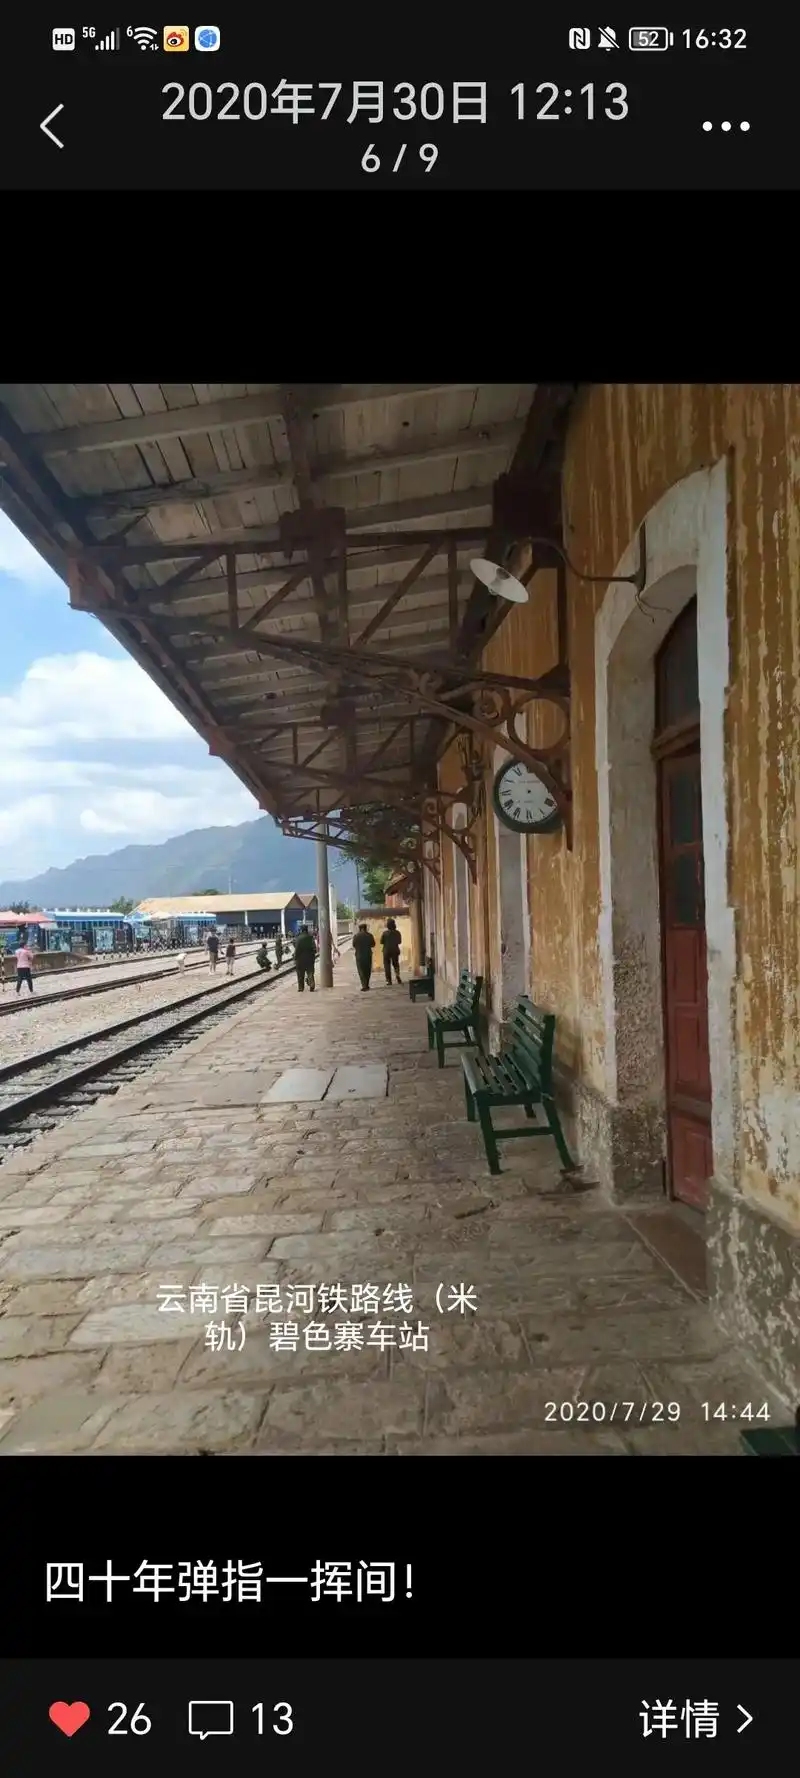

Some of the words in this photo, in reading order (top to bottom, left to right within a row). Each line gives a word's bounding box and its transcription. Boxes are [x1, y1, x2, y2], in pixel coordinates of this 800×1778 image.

[54, 33, 73, 45] HD
[82, 26, 96, 38] 5G
[638, 31, 659, 47] 52
[682, 28, 747, 49] 16:32
[161, 79, 487, 124] 2020年7月30日
[510, 82, 629, 121] 12:13
[360, 144, 381, 173] 6
[418, 144, 439, 173] 9
[107, 1702, 152, 1736] 26
[251, 1702, 294, 1736] 13
[638, 1698, 720, 1739] 详情
